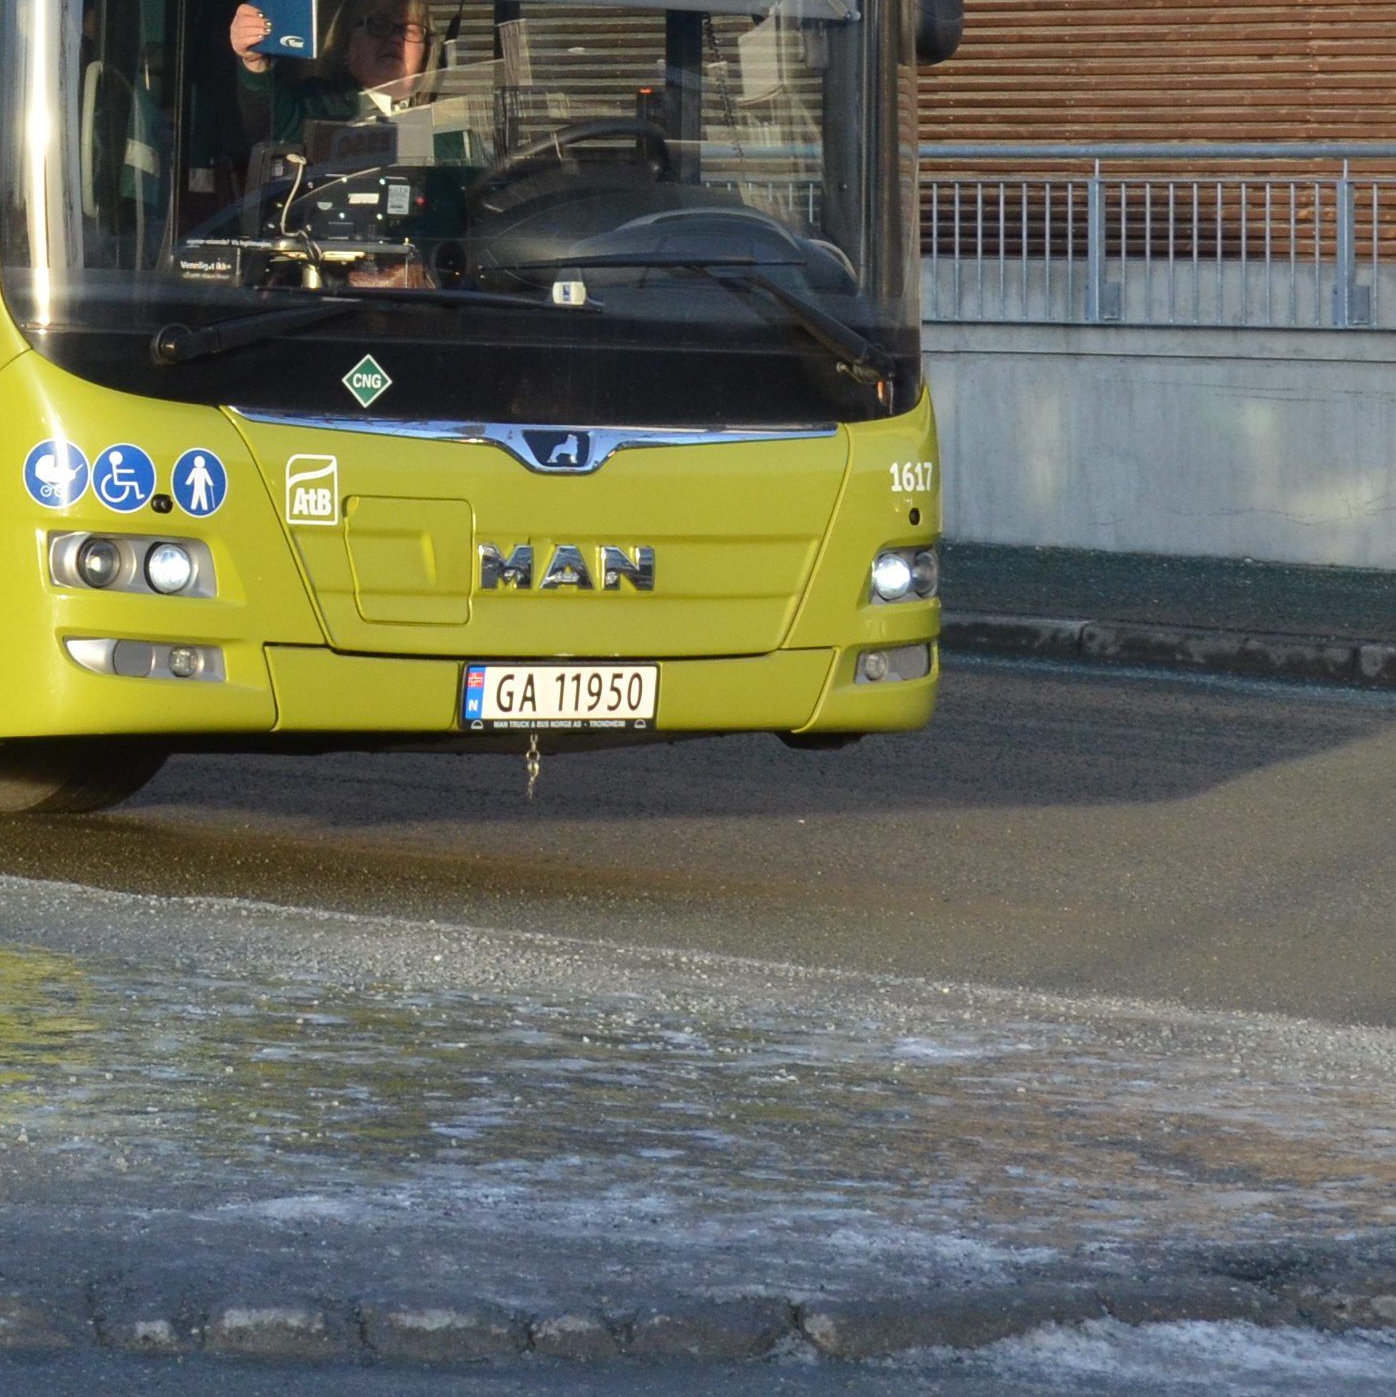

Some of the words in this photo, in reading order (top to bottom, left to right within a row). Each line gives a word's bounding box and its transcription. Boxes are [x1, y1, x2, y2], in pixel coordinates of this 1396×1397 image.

[352, 373, 381, 389] CNG
[889, 462, 932, 491] 1617
[292, 487, 332, 516] AtB
[478, 544, 655, 591] MAN
[468, 699, 479, 711] N
[496, 673, 537, 712] GA
[556, 672, 643, 712] 11950
